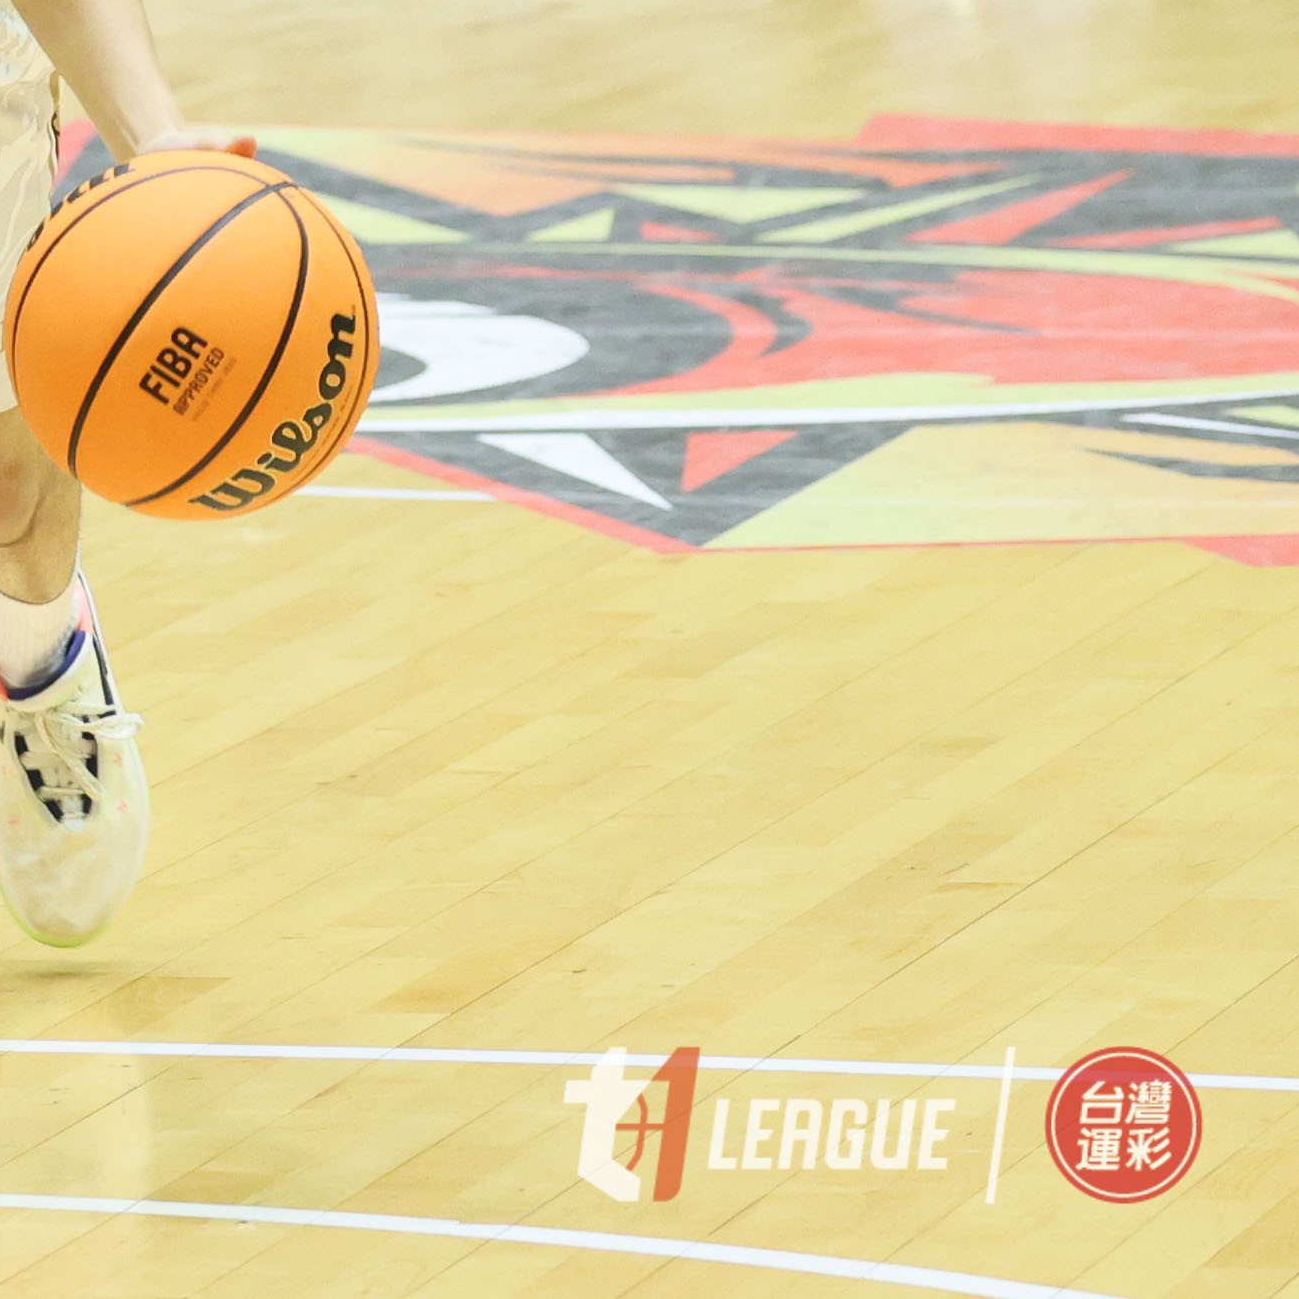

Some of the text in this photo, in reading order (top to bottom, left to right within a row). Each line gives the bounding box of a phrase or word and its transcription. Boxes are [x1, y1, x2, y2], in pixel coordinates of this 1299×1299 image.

[139, 327, 208, 404] FIBA
[173, 347, 225, 415] APPROVED
[187, 312, 356, 511] Wilson
